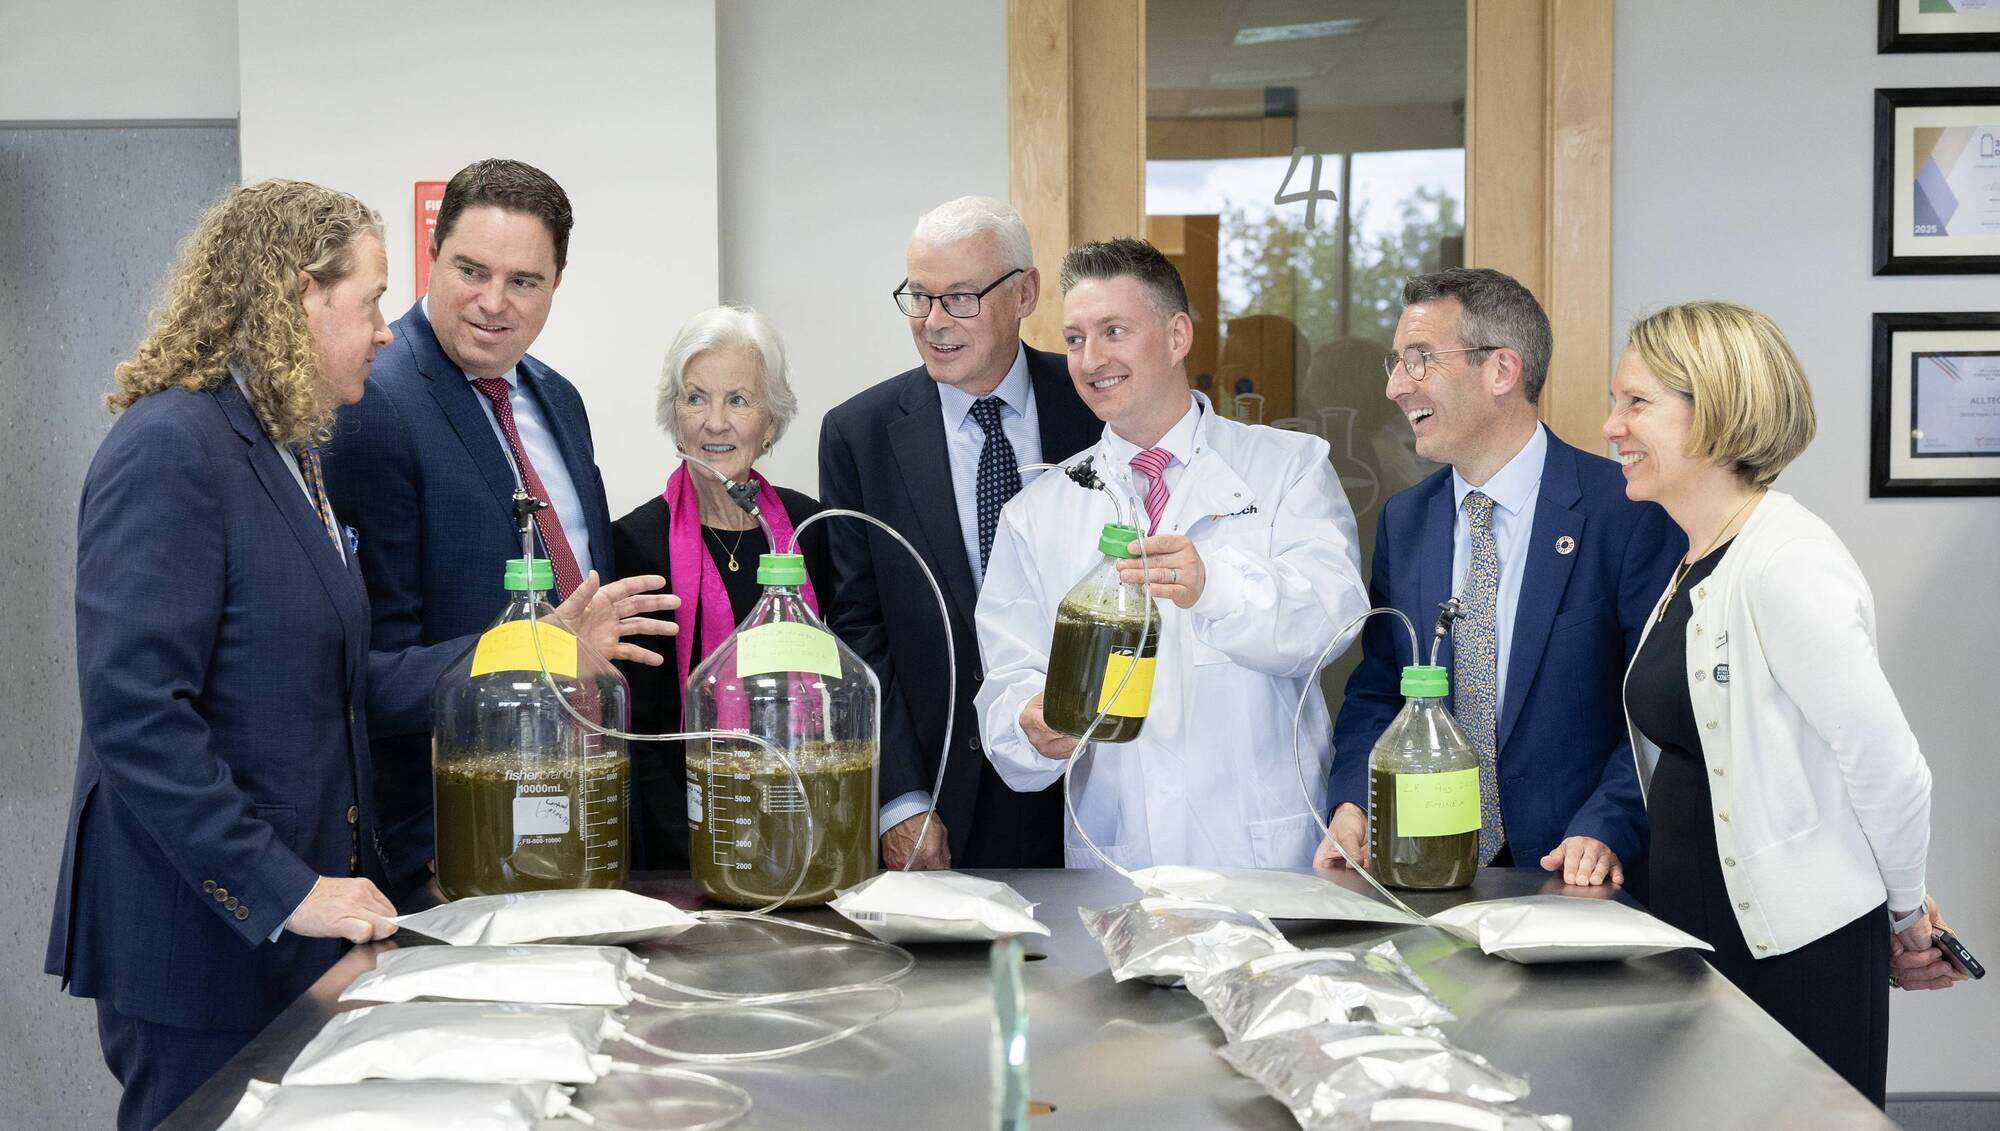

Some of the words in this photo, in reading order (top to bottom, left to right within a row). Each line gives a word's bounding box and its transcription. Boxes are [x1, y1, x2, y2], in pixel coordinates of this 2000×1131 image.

[1274, 146, 1337, 229] 4
[425, 199, 442, 211] FIR
[519, 784, 564, 793] 10000mL
[734, 795, 751, 803] 5000
[735, 817, 751, 825] 4000
[736, 840, 752, 848] 3000
[736, 863, 752, 871] 2000
